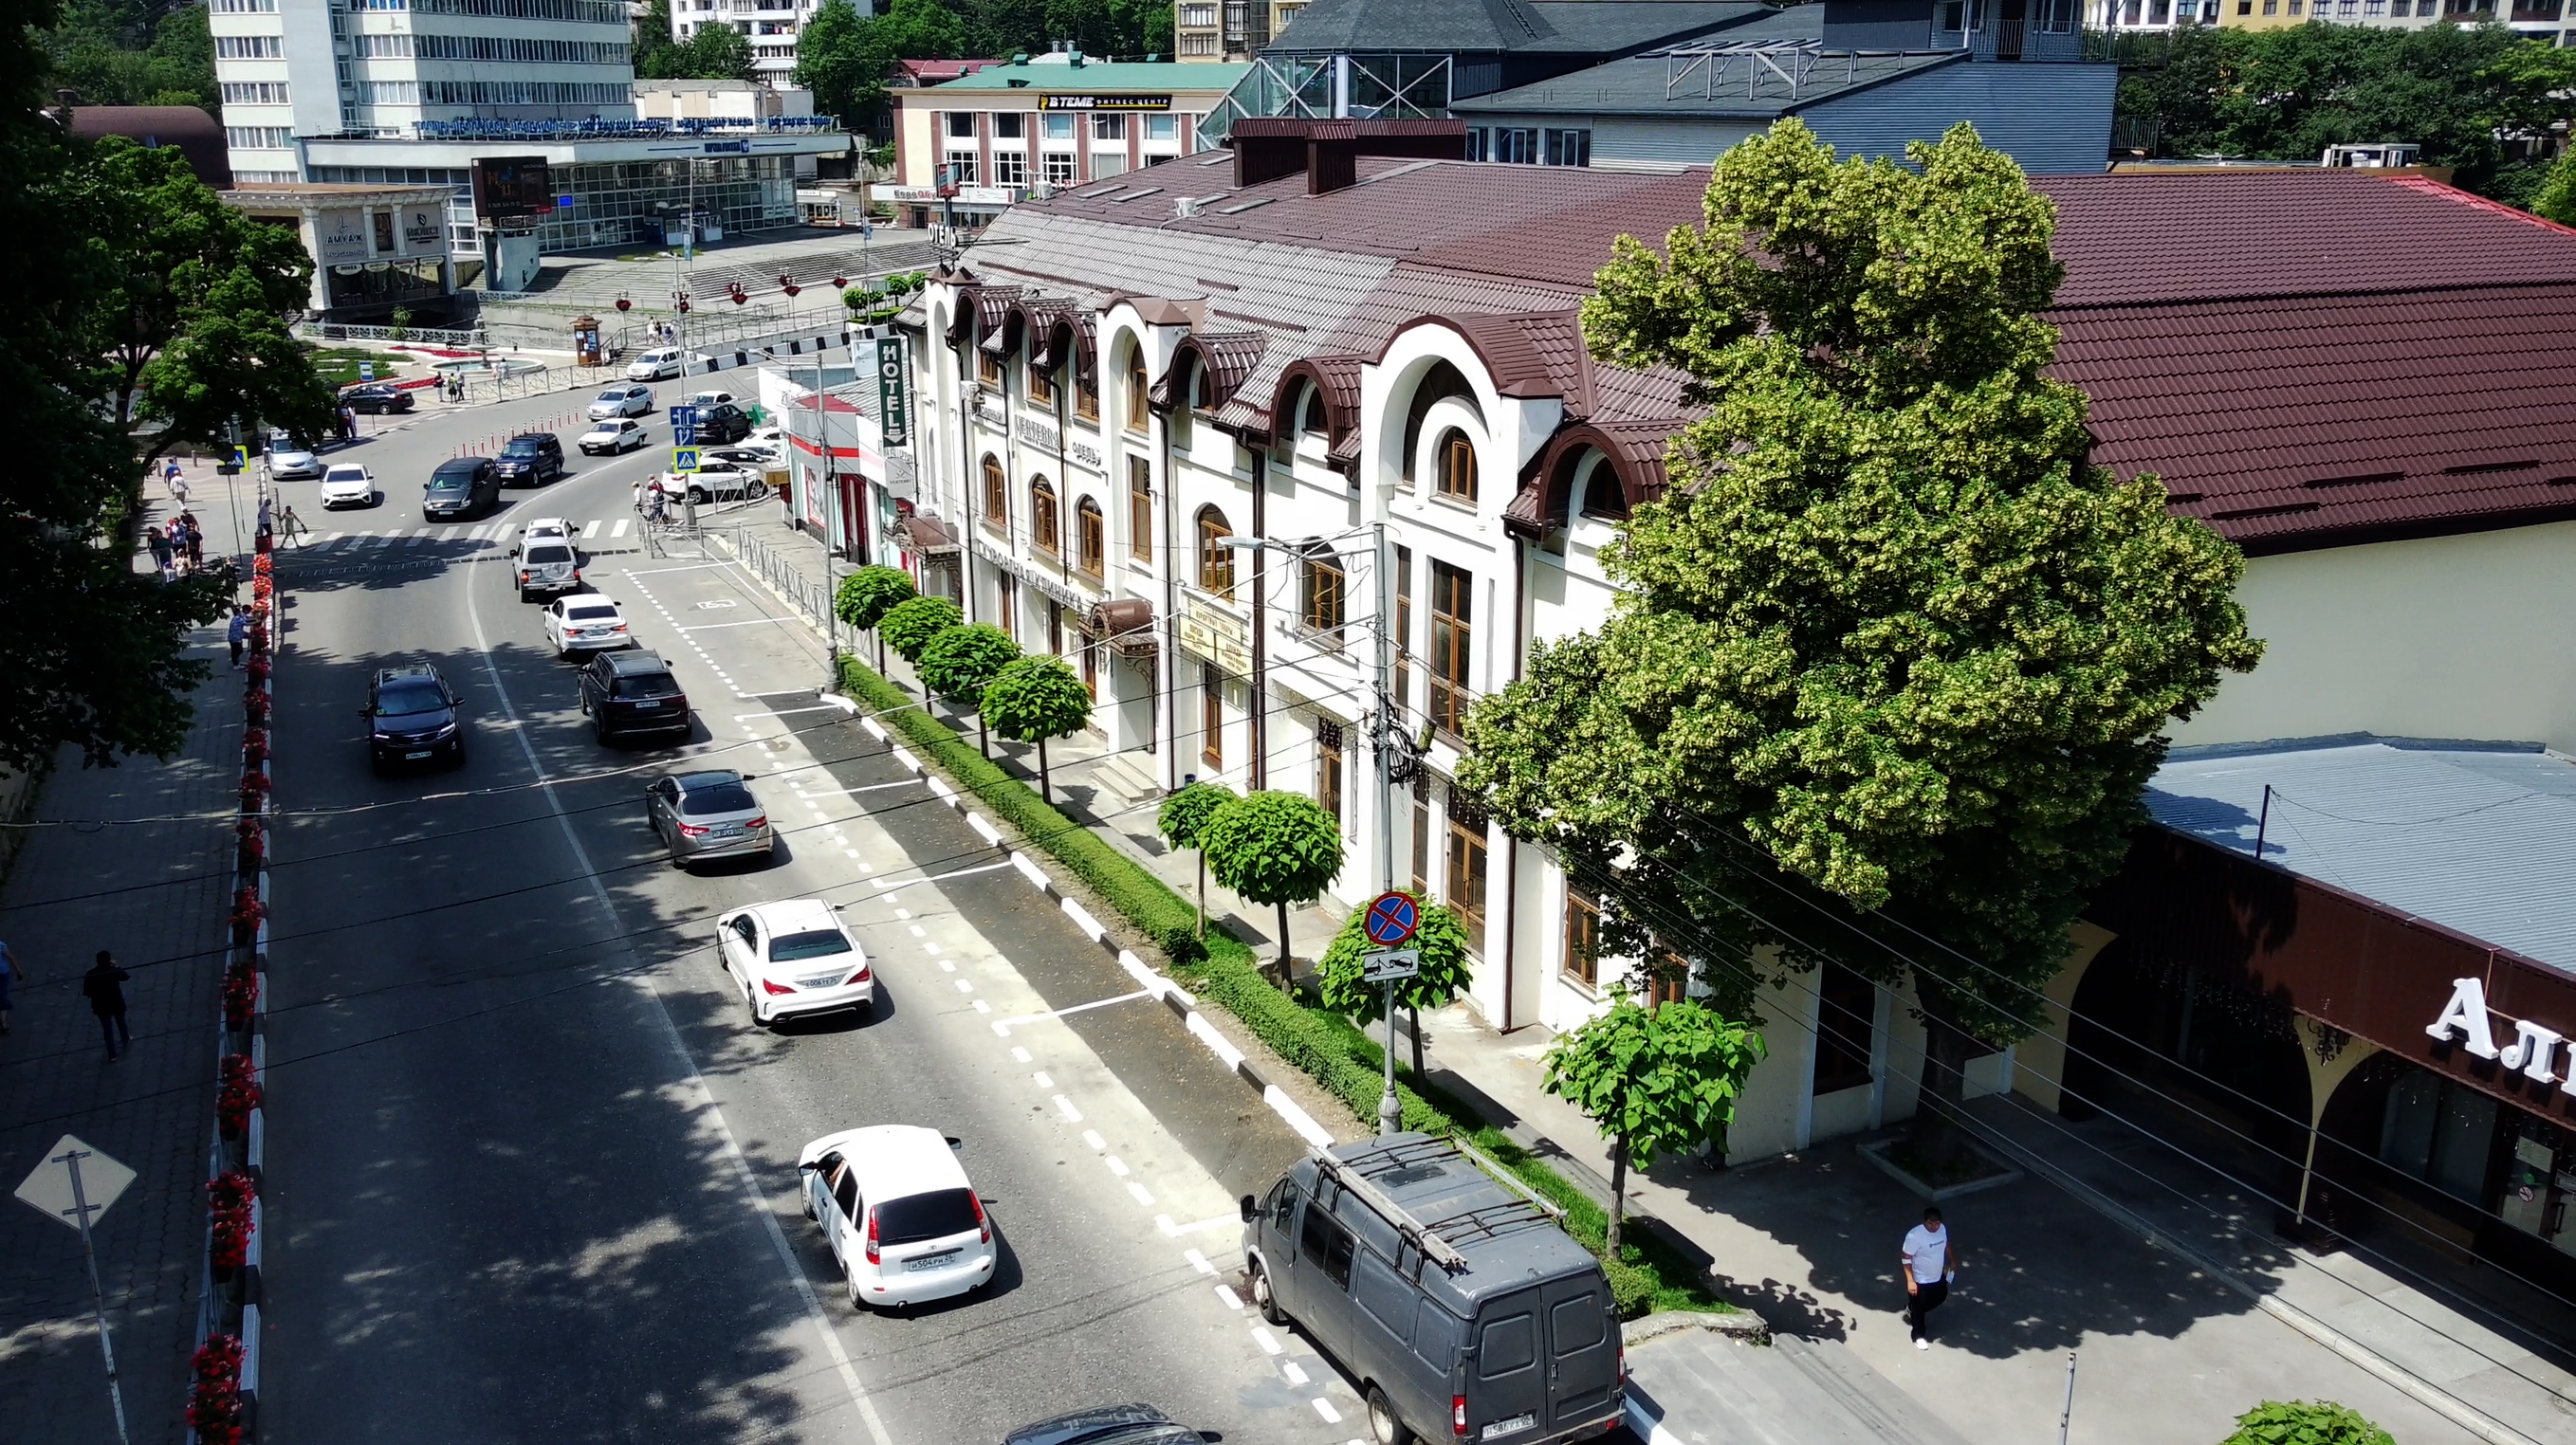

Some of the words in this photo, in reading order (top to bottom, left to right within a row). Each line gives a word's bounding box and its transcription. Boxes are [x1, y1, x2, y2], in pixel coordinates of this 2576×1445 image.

[1049, 97, 1058, 107] В
[1060, 97, 1095, 107] ТЕМЕ
[882, 345, 900, 428] HOTEL
[1014, 413, 1060, 449] VERTEBRA
